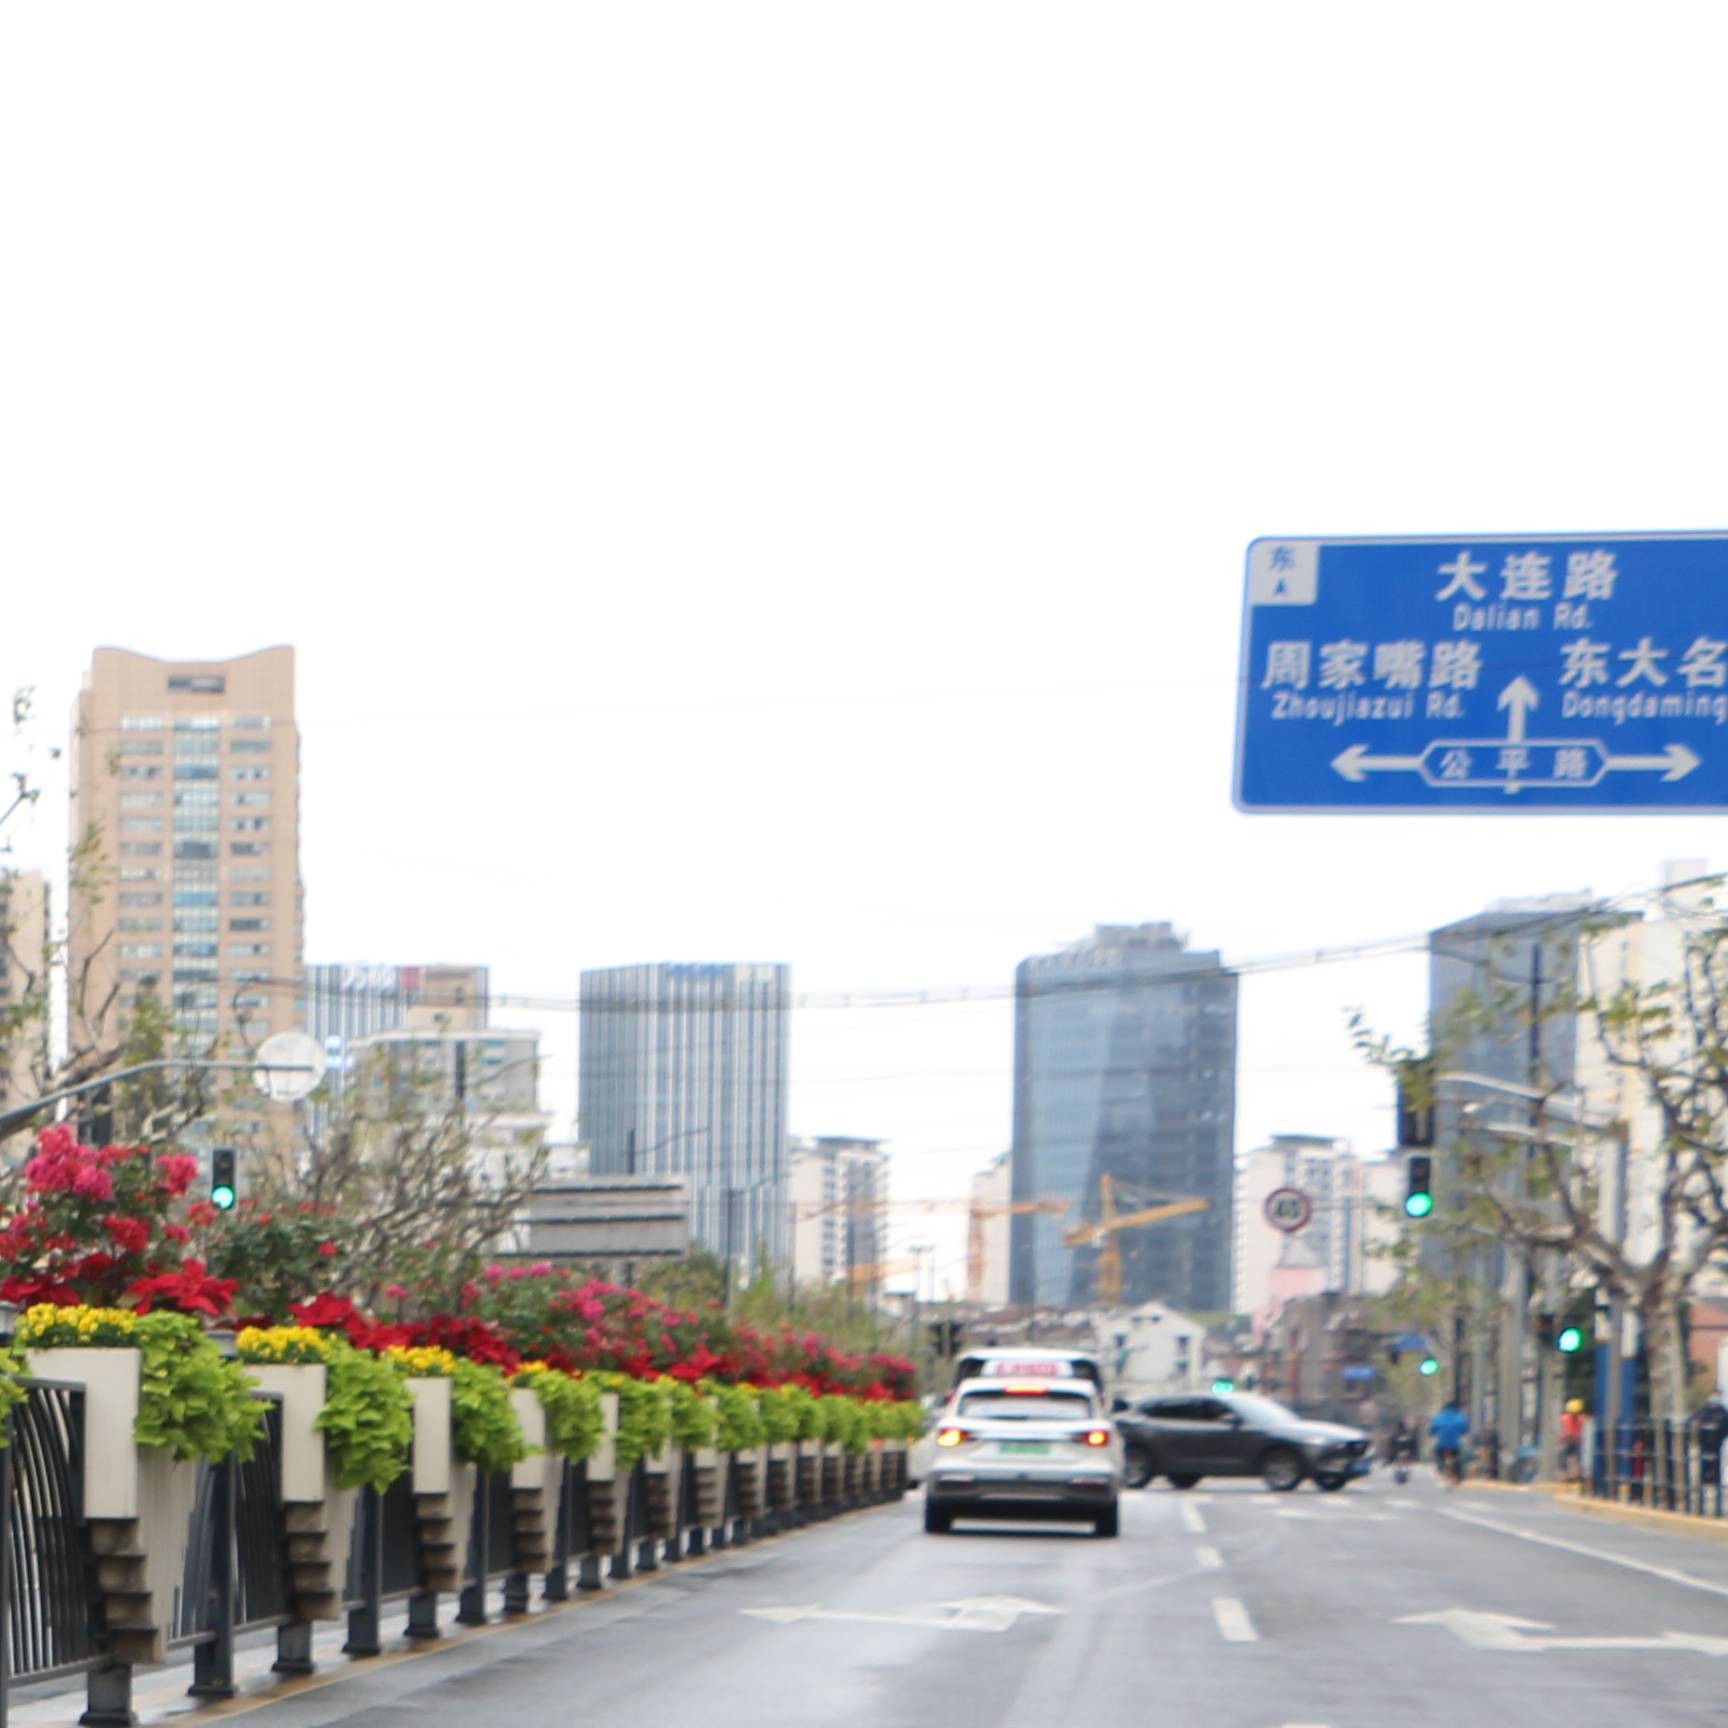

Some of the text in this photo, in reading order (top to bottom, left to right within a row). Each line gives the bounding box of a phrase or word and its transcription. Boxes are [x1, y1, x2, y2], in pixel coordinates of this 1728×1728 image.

[1435, 551, 1618, 600] 大连路
[1453, 602, 1593, 631] Dalian Rd.
[1260, 639, 1482, 690] 周家嘴路
[1558, 637, 1728, 687] 东大名
[1272, 690, 1466, 727] Zhoujiazui Rd.
[1562, 690, 1728, 725] Dongdaming
[1440, 748, 1588, 780] 公平路
